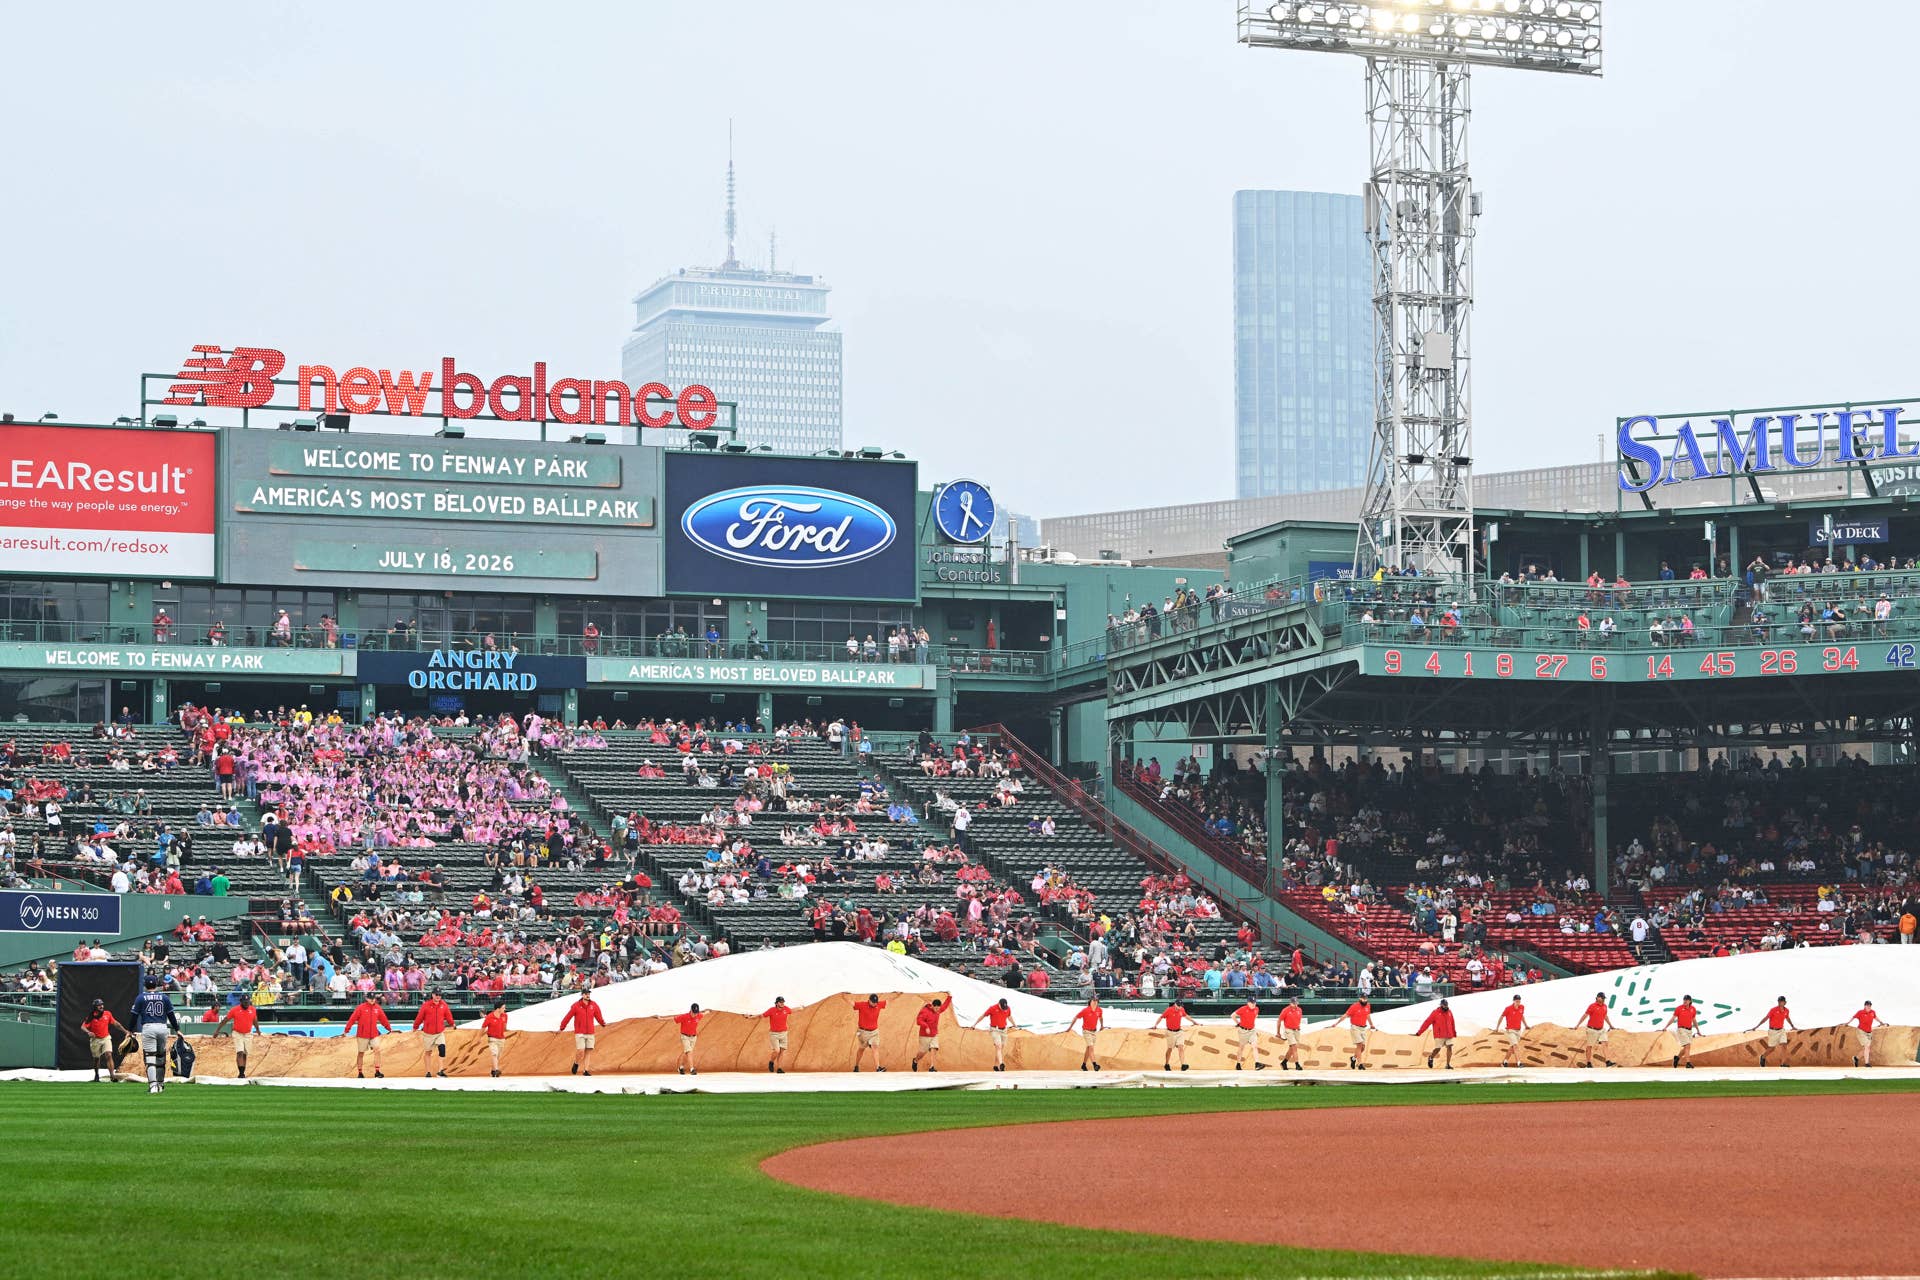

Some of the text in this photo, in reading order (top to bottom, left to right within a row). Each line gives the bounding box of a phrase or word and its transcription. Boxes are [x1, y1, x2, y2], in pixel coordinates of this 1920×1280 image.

[699, 285, 800, 300] PRUDENTIAL
[298, 364, 434, 417] new
[441, 356, 718, 430] balance
[1617, 407, 1920, 493] SAMUEL
[303, 448, 589, 479] WELCOME TO FENWAY PARK
[30, 497, 48, 509] the
[51, 502, 73, 512] way
[76, 501, 115, 513] people
[119, 503, 138, 512] use
[251, 486, 639, 519] AMERICA'S MOST BELOVED BALLPARK
[725, 497, 854, 554] Ford
[1845, 527, 1881, 539] DECK
[0, 535, 169, 555] aresult.com/redsox
[378, 550, 515, 574] JULY 18, 2026
[926, 547, 988, 565] Johnson
[937, 566, 1001, 583] Controls
[46, 650, 264, 669] WELCOME TO FENWAY PARK
[428, 649, 518, 670] ANGRY
[1385, 643, 1916, 680] 9 4 1 8 27 6 14 45 26 34 42
[408, 669, 538, 692] ORCHARD
[628, 665, 896, 684] AMERICA'S MOST BELOVED BALLPARK
[365, 698, 373, 707] 41
[567, 703, 576, 711] 42
[46, 906, 99, 920] NESN 360
[146, 1001, 164, 1017] 40
